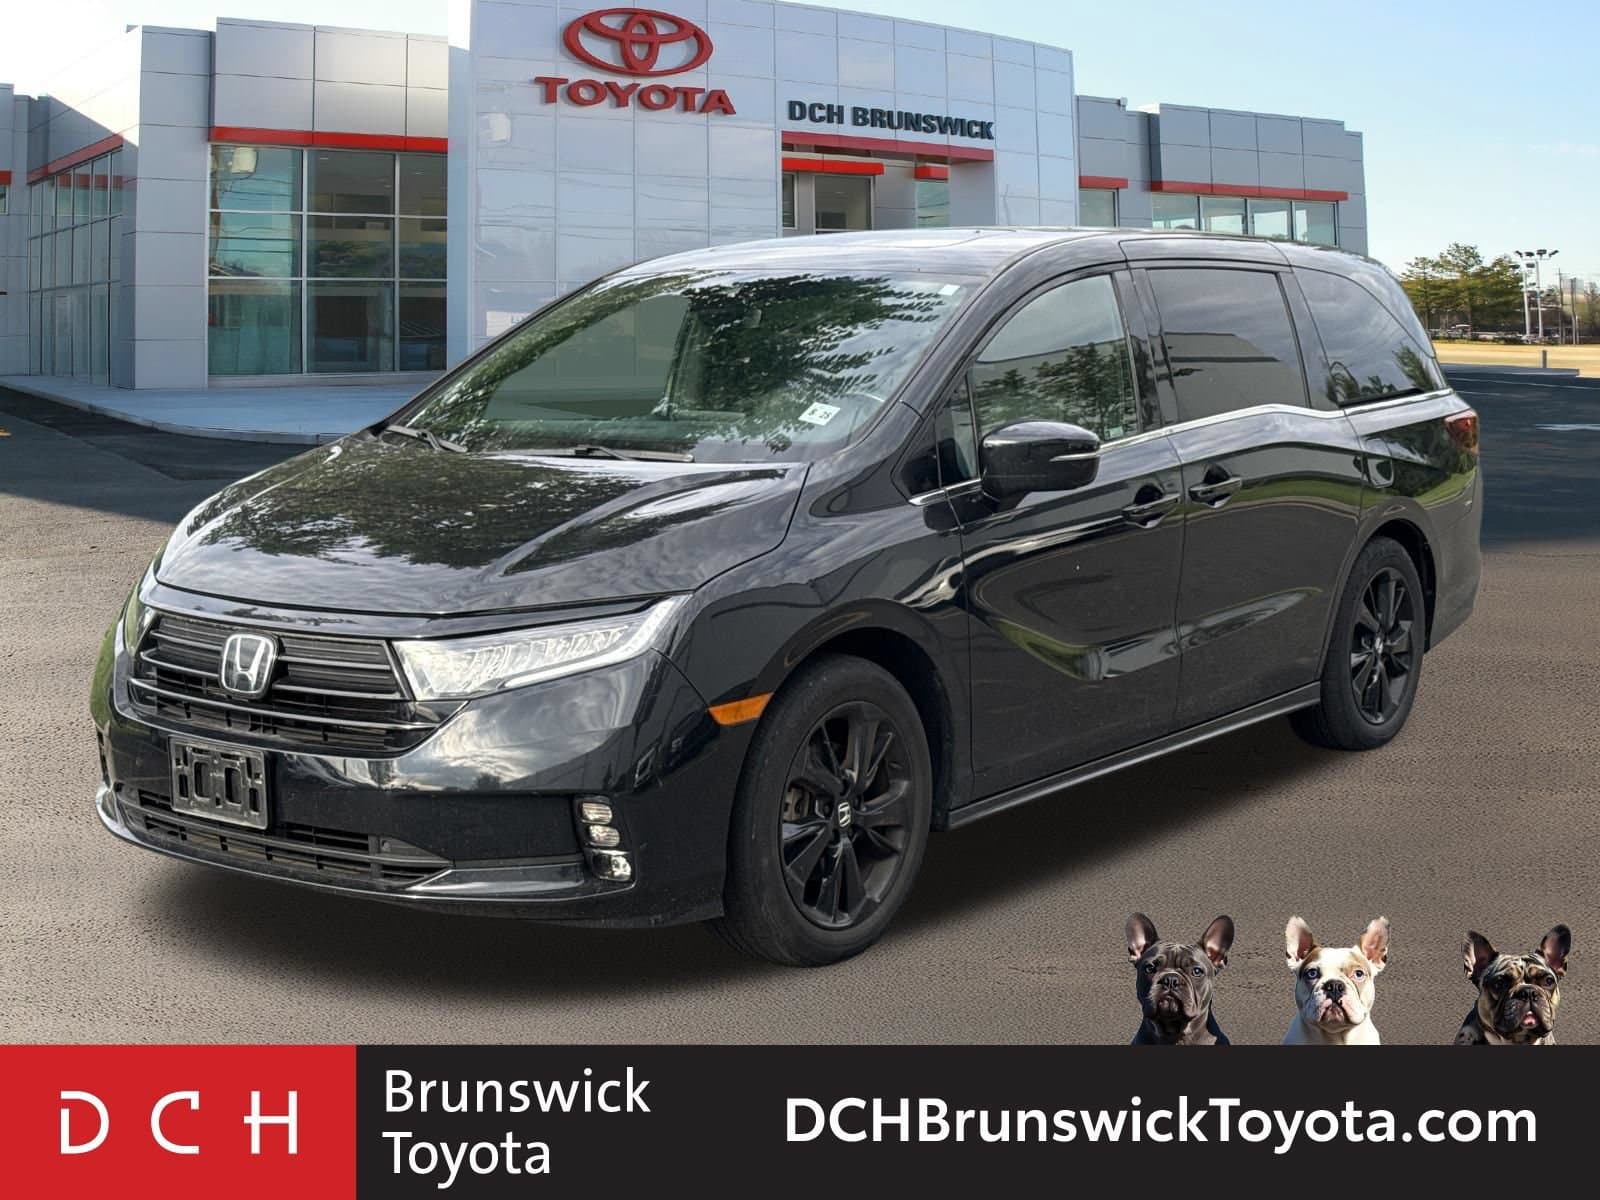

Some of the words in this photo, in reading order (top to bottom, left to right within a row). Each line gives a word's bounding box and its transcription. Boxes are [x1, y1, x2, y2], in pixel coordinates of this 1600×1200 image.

[534, 76, 737, 114] TOYOTA
[787, 100, 844, 124] DCH
[852, 106, 994, 140] BRUNSWICK
